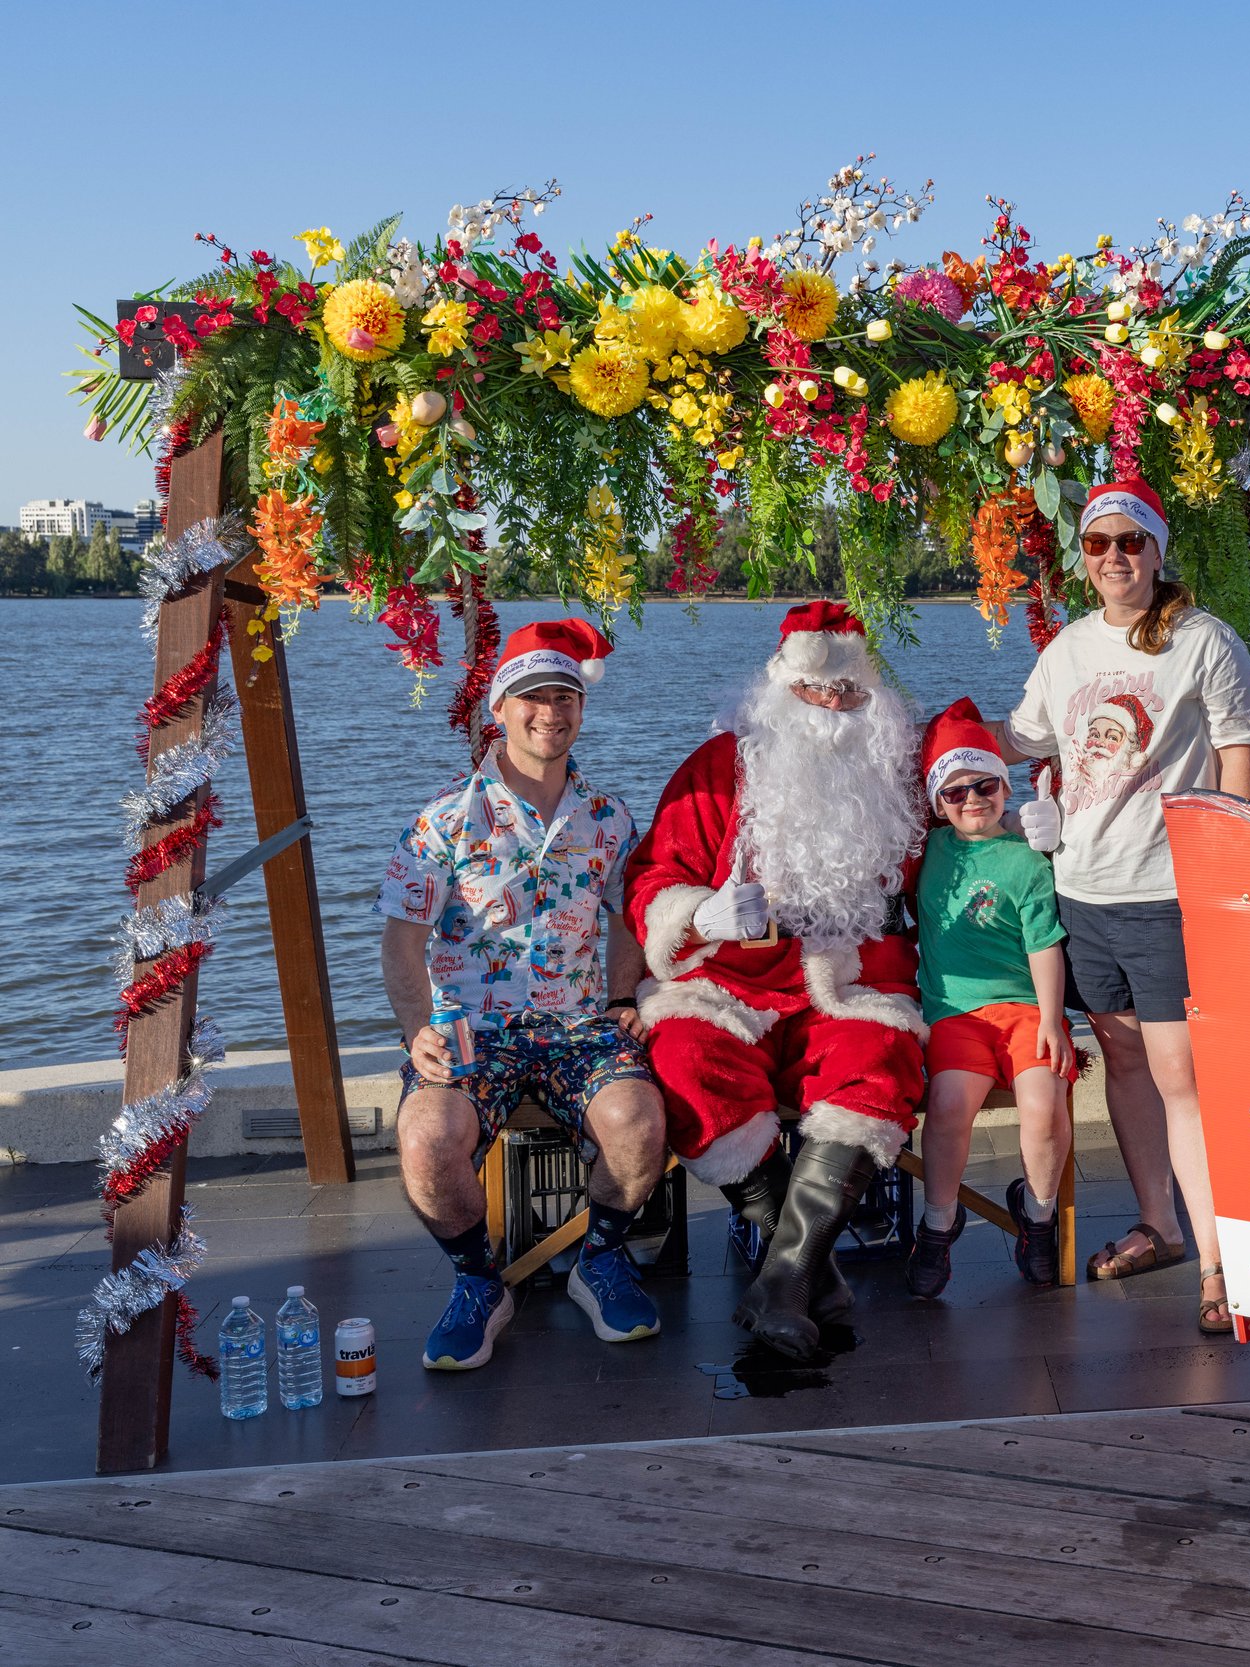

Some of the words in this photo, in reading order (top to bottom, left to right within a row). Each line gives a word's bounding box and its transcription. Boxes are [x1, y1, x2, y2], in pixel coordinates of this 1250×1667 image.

[1097, 497, 1129, 512] Santa
[1130, 501, 1148, 519] Run
[528, 653, 562, 670] Santa
[1063, 671, 1165, 735] Merry
[938, 752, 961, 778] Santa
[961, 750, 985, 762] Run
[553, 910, 579, 925] Merry
[536, 989, 559, 1001] Merry
